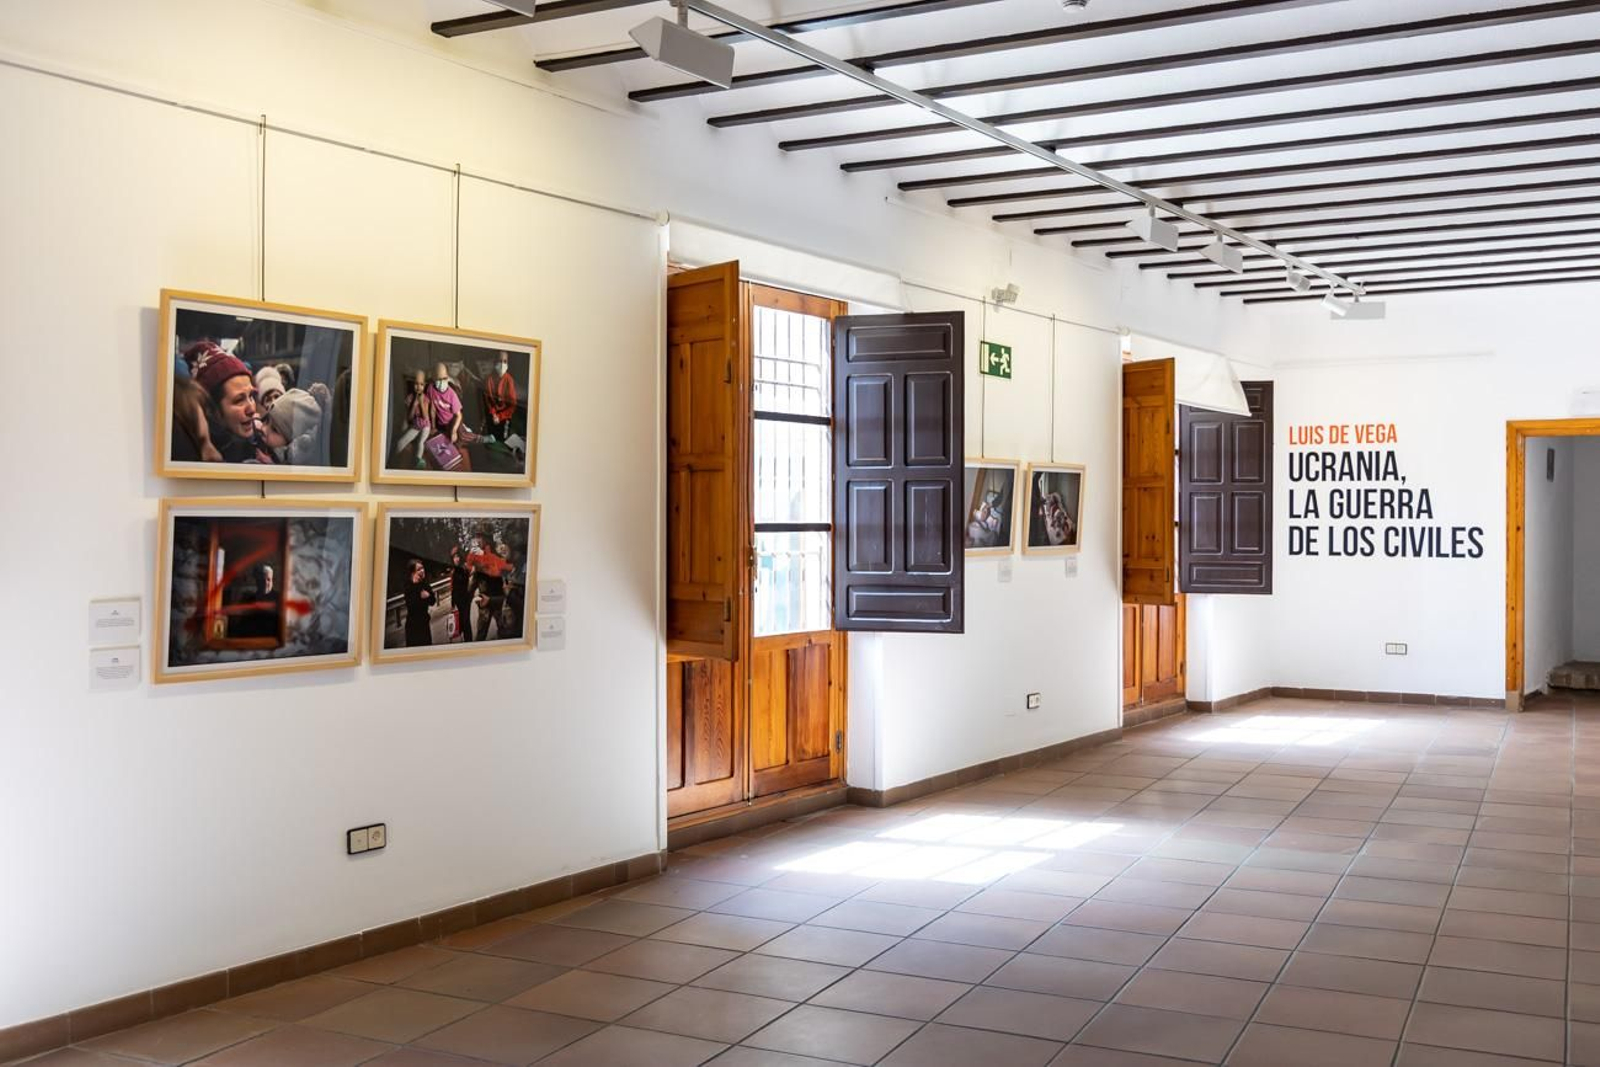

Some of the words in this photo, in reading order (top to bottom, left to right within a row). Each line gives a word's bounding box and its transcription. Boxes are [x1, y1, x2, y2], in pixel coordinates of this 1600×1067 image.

[1289, 425, 1324, 445] LUIS
[1329, 424, 1349, 445] DE
[1355, 423, 1397, 444] VEGA
[1289, 450, 1406, 485] UCRANIA,
[1289, 489, 1320, 519] LA
[1329, 488, 1433, 519] GUERRA
[1289, 526, 1319, 556] DE
[1328, 526, 1375, 557] LOS
[1384, 526, 1484, 558] CIVILES
